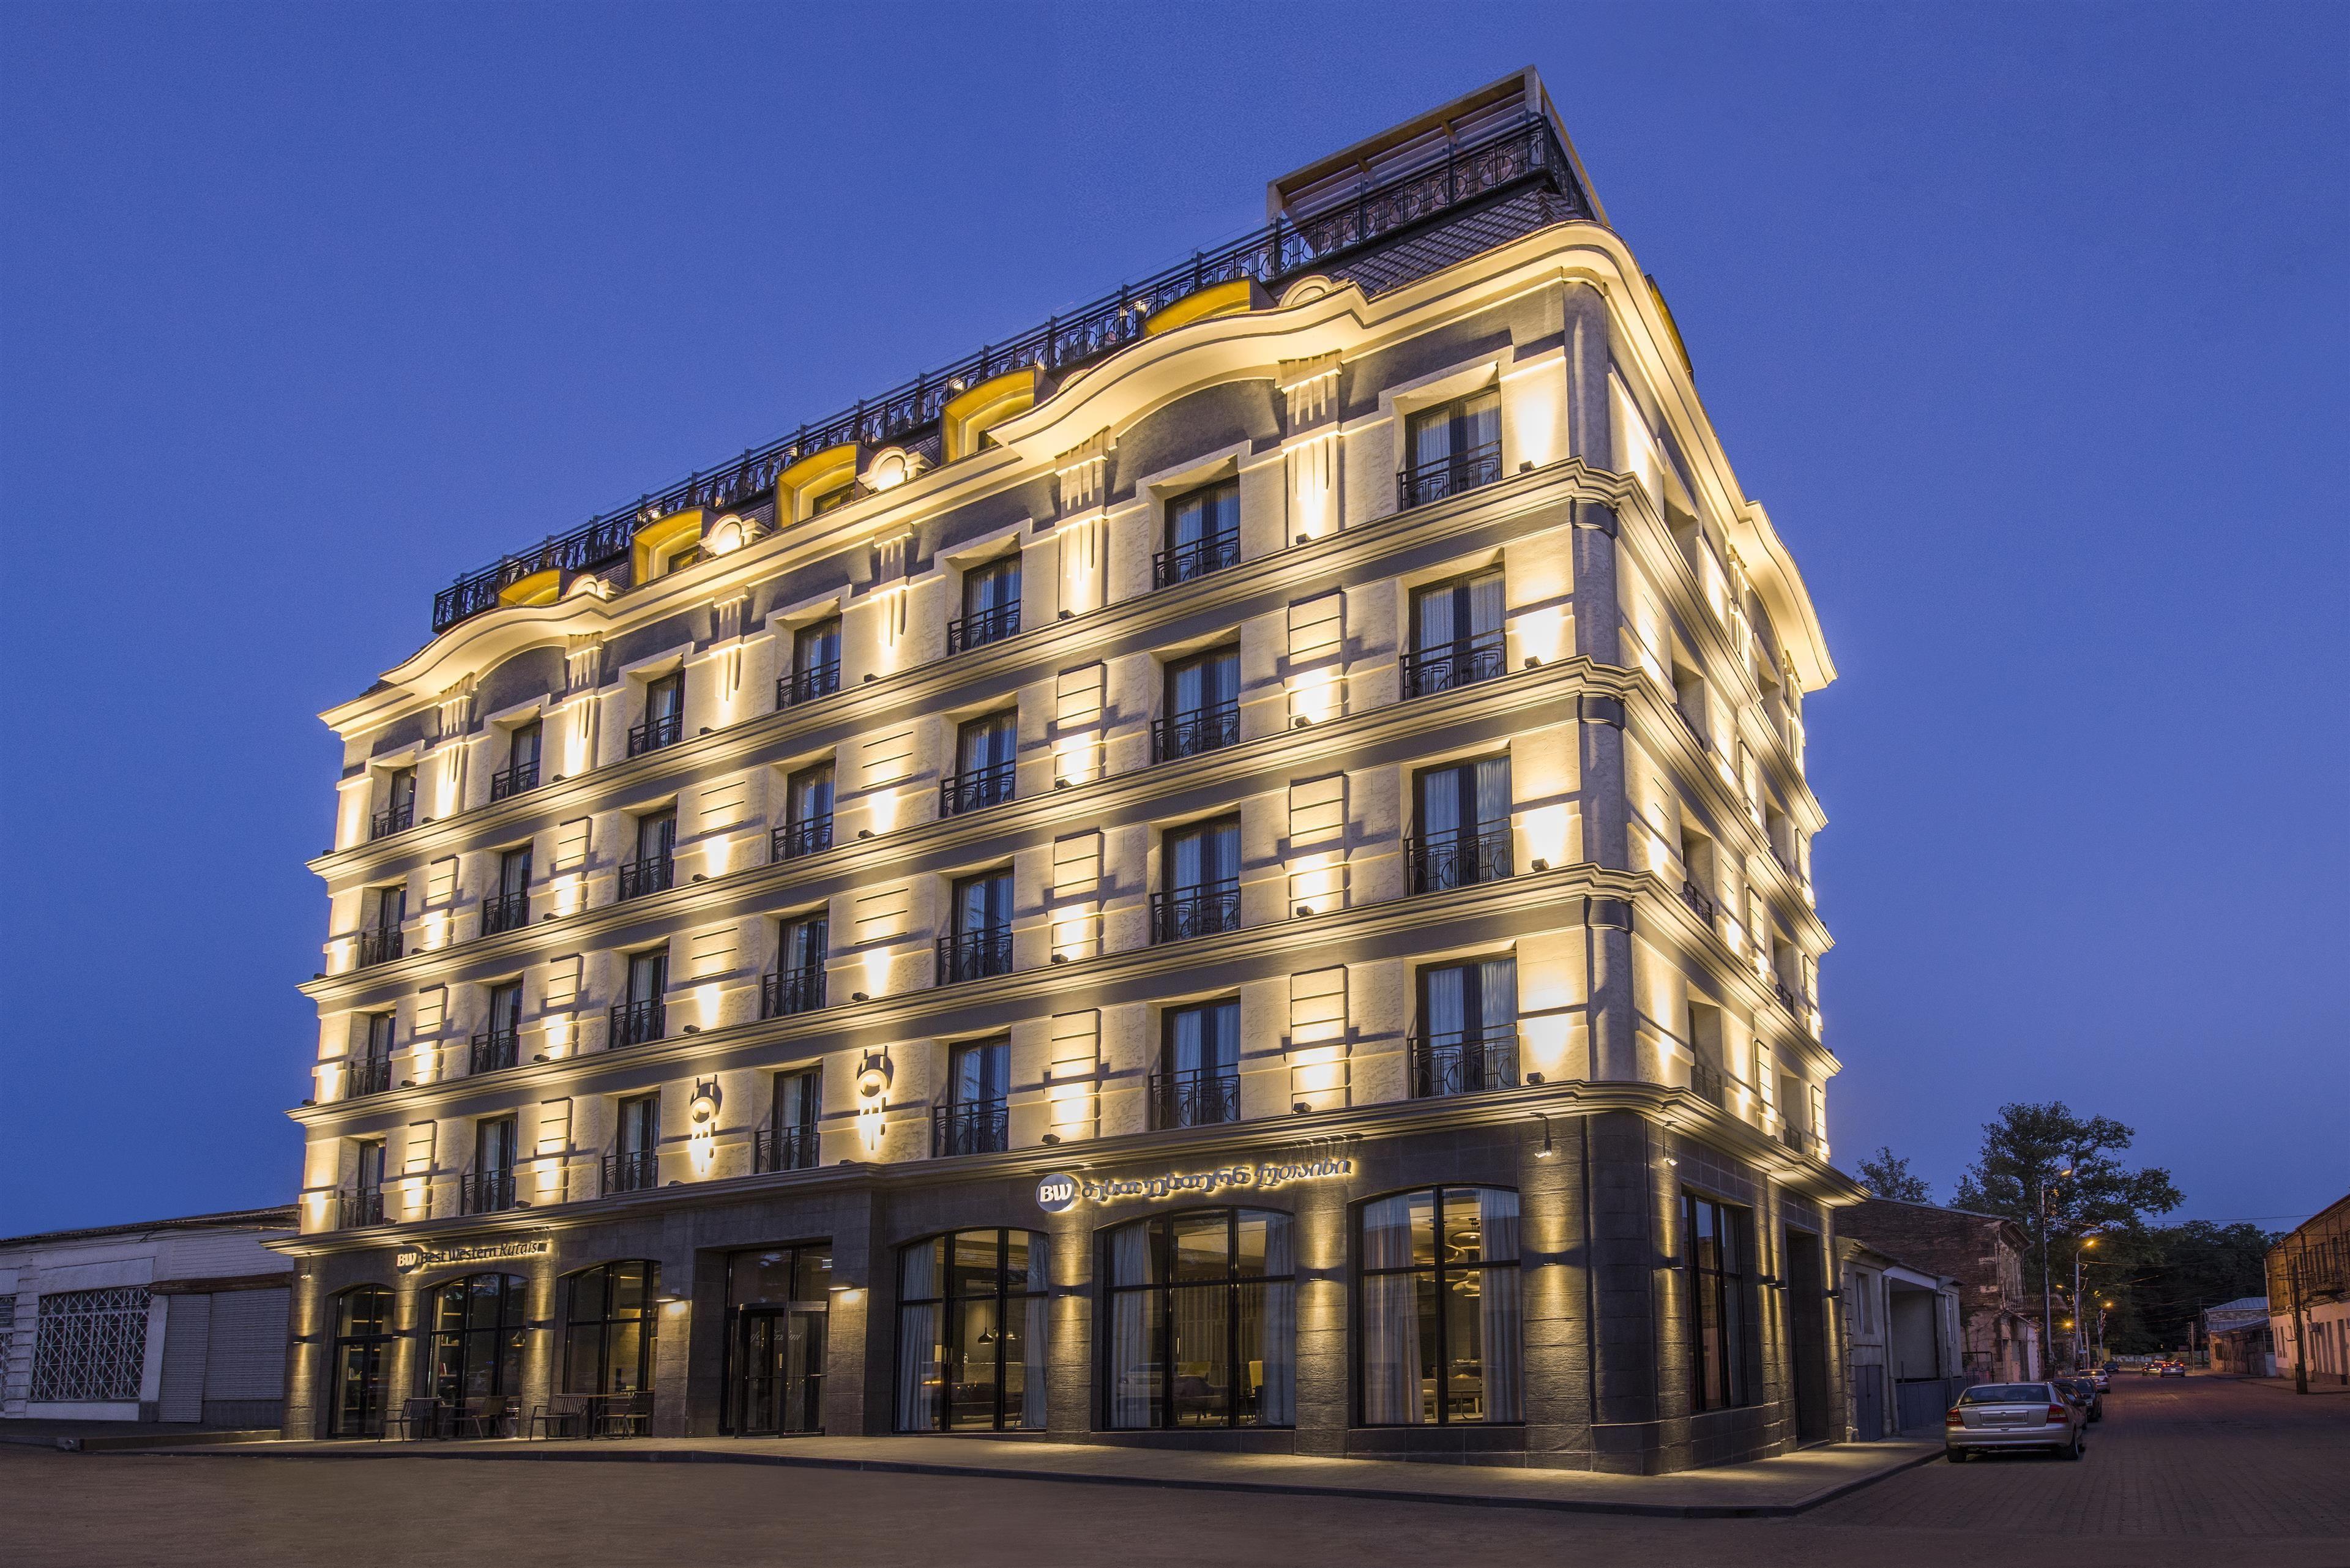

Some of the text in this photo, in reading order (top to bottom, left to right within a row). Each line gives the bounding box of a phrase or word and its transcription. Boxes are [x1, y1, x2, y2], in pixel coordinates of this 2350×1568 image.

[1081, 1179, 1138, 1203] ბესთ
[1253, 1157, 1350, 1187] ქუთაისი
[1040, 1183, 1072, 1202] BW
[397, 1252, 417, 1267] BW
[421, 1250, 446, 1264] Best
[448, 1246, 497, 1262] Western
